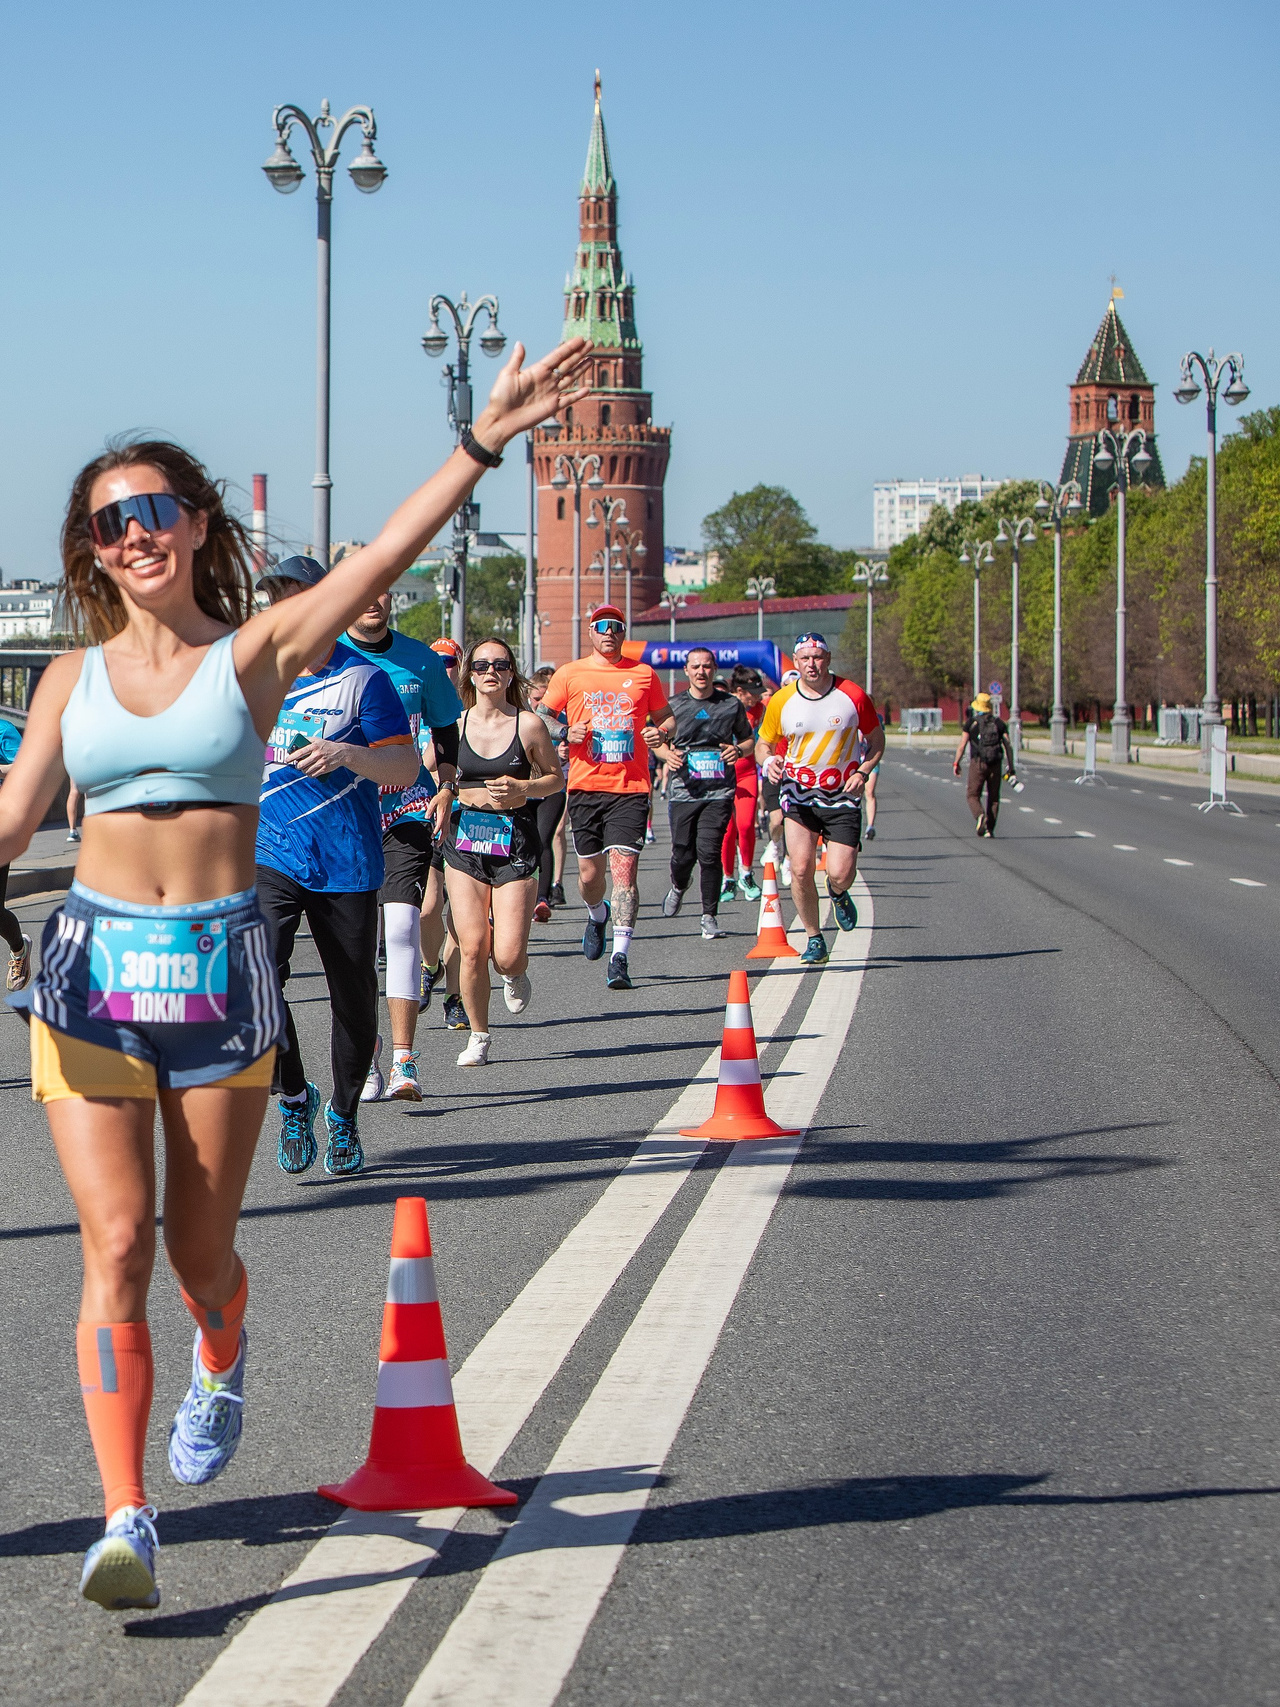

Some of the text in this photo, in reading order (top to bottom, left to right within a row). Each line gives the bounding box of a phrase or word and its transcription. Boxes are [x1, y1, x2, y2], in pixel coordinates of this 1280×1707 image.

[669, 649, 739, 662] ПС КМ
[605, 752, 623, 762] 10KM
[468, 824, 500, 842] 31067
[471, 840, 493, 854] 10KM
[120, 950, 199, 990] 30113
[130, 992, 186, 1024] 10KM
